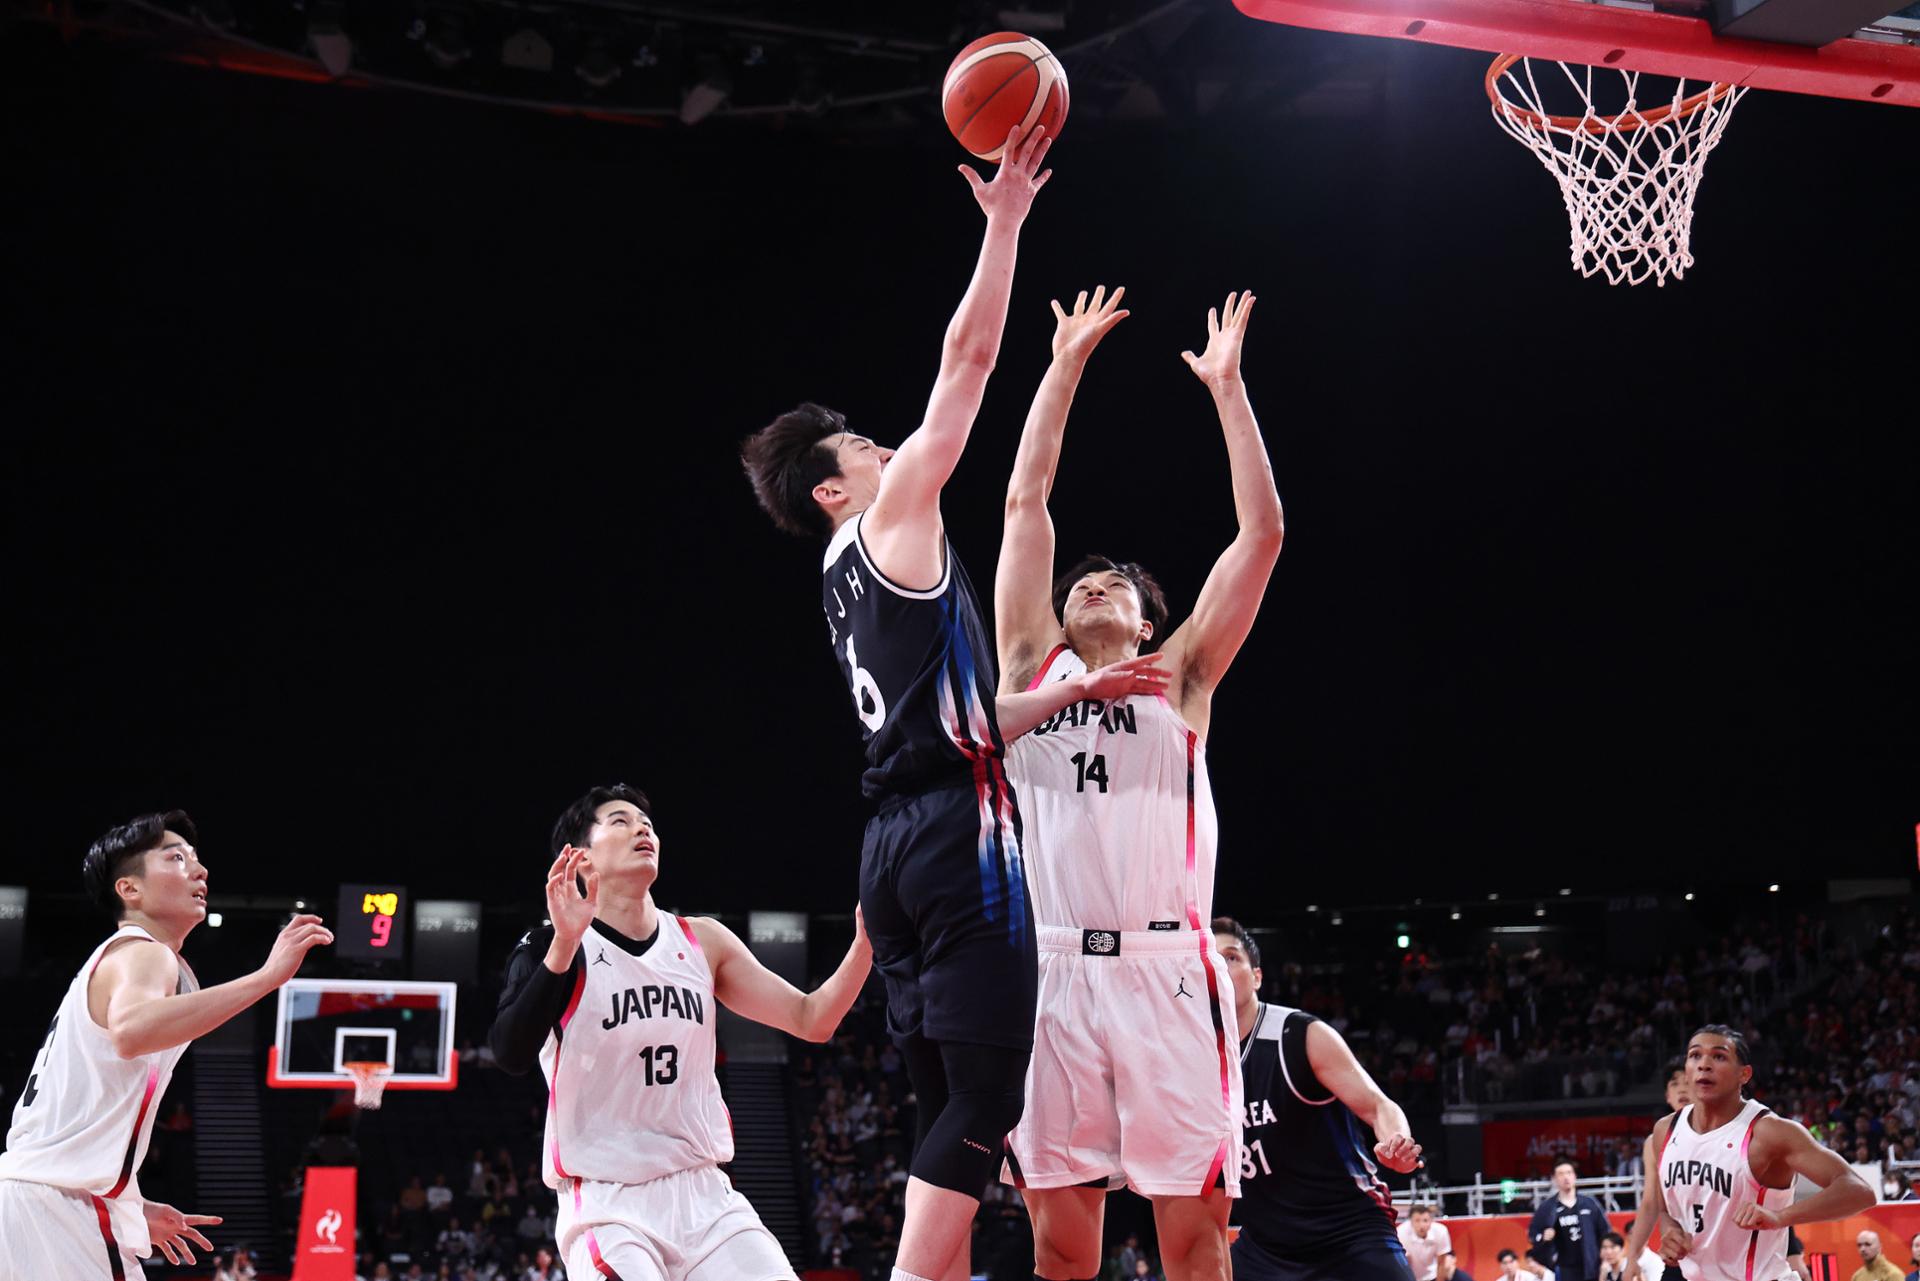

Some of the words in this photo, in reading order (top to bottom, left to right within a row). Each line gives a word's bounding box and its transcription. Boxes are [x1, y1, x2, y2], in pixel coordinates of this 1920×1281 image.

[1033, 698, 1138, 736] JAPAN
[1069, 751, 1109, 794] 14
[370, 914, 393, 947] 9
[601, 984, 704, 1031] JAPAN
[638, 1044, 679, 1087] 13
[1242, 1098, 1278, 1129] REA
[1664, 1160, 1733, 1199] JAPAN
[1692, 1203, 1705, 1234] 5
